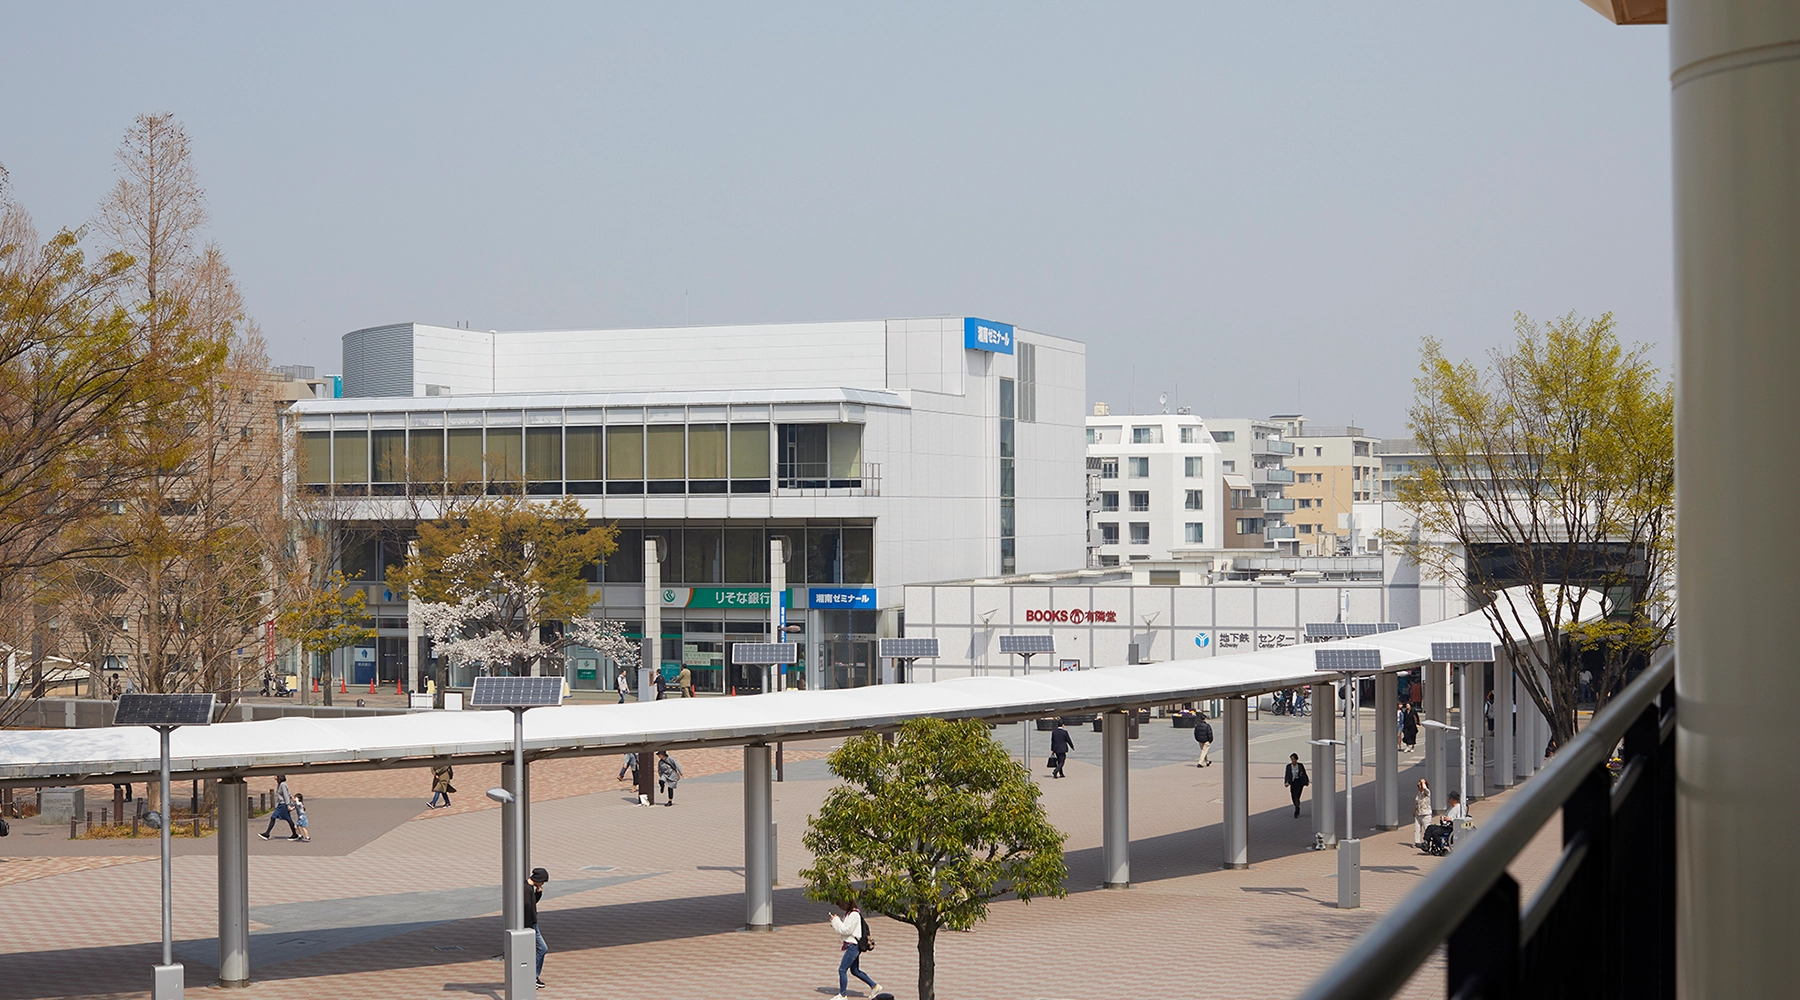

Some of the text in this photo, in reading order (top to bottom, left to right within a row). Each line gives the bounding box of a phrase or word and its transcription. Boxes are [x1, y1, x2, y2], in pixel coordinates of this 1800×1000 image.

[715, 591, 770, 604] りそな銀行
[816, 593, 869, 603] 湘南ゼミナール
[1026, 610, 1117, 623] BOOKS 有隣堂
[1219, 632, 1250, 643] 地下鉄
[1258, 633, 1295, 643] センター
